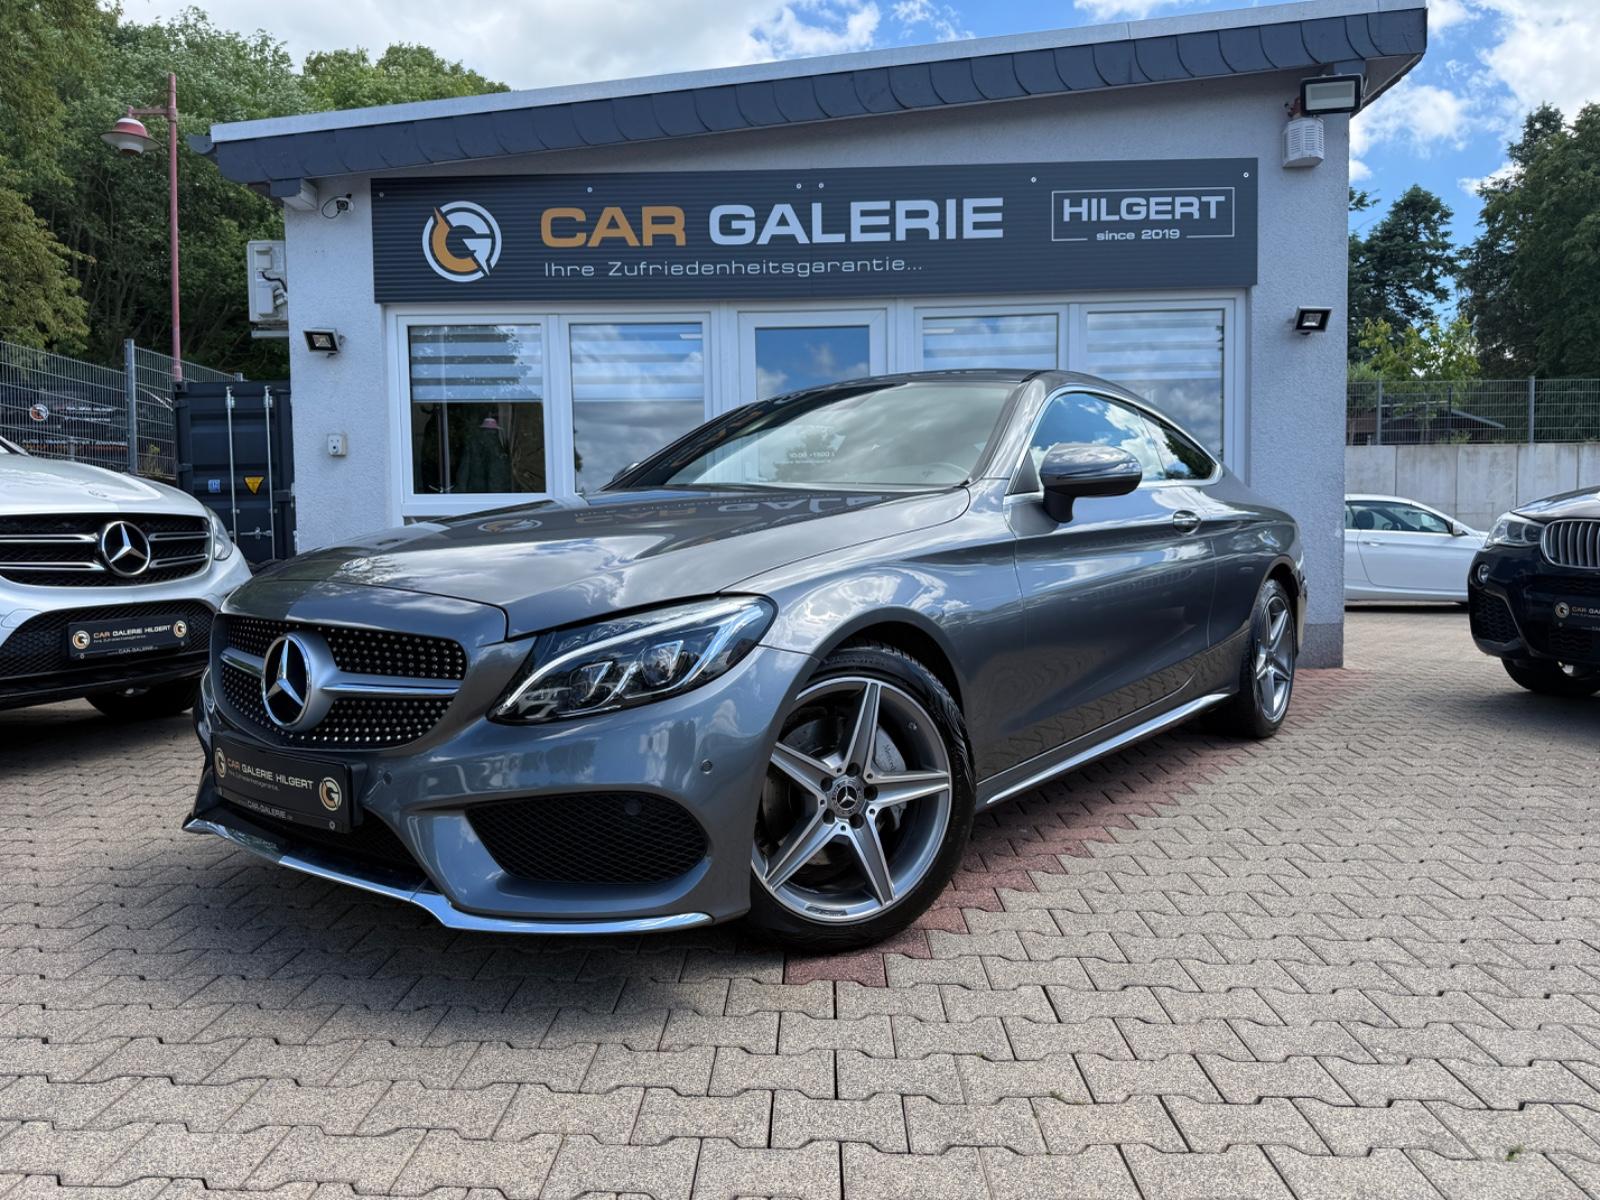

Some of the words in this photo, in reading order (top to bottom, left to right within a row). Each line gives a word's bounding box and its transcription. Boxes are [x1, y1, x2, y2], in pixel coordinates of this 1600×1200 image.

[1063, 196, 1225, 222] HILGERT
[540, 206, 686, 247] CAR
[709, 197, 1004, 246] GALERIE
[1096, 229, 1135, 241] since
[1141, 228, 1180, 240] 2019
[544, 261, 595, 277] Ihre
[608, 257, 923, 278] Zufriedenheitsgarantie...
[93, 631, 110, 639] CAR
[112, 627, 143, 637] GALERIE
[144, 624, 171, 633] HILGERT
[227, 757, 240, 769] CAR
[241, 763, 274, 781] GALERIE
[275, 773, 315, 790] HILGERT
